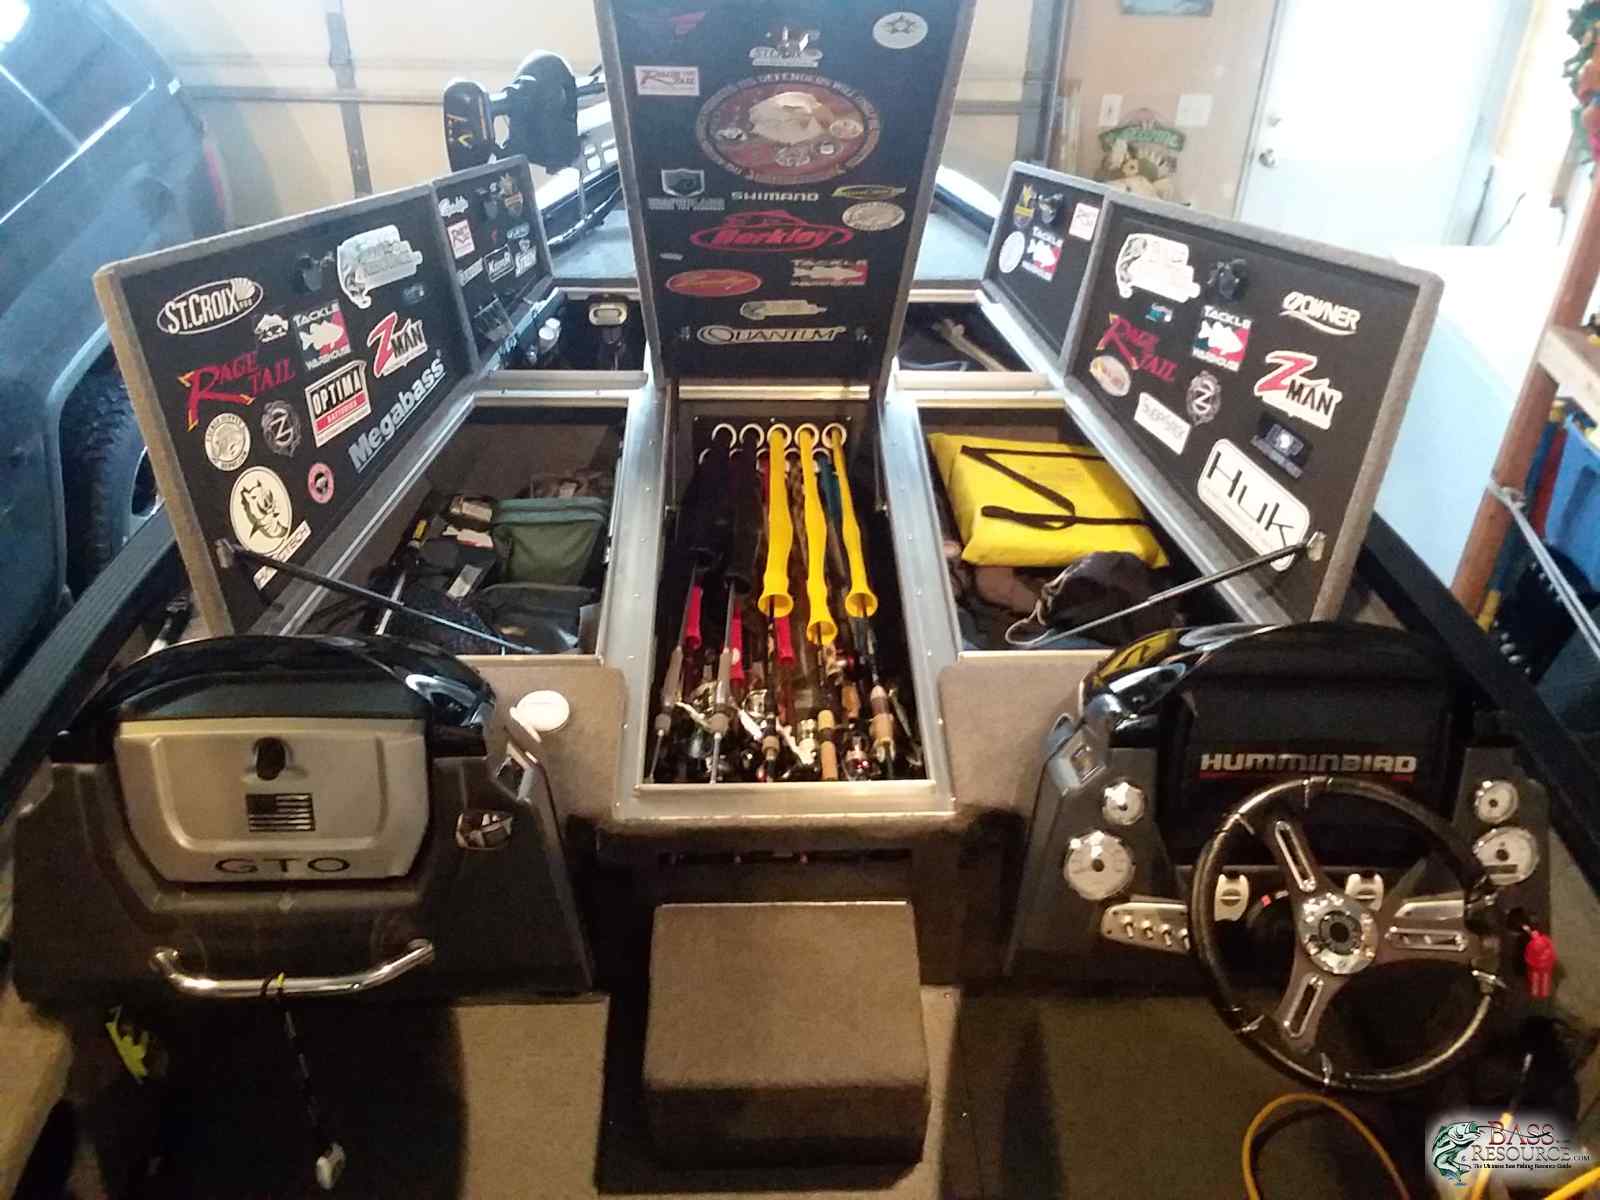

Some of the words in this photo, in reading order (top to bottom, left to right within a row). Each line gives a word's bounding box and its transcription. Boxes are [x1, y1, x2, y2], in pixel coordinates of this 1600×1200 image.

[731, 191, 819, 202] SHIMANO
[710, 227, 834, 248] Berkley
[292, 300, 340, 327] TACKLE
[1203, 304, 1252, 329] TACKLE
[312, 369, 362, 416] OPTIMA
[348, 358, 445, 470] Megabass
[1200, 753, 1417, 773] HUMMINBIRD
[215, 856, 350, 874] GTO
